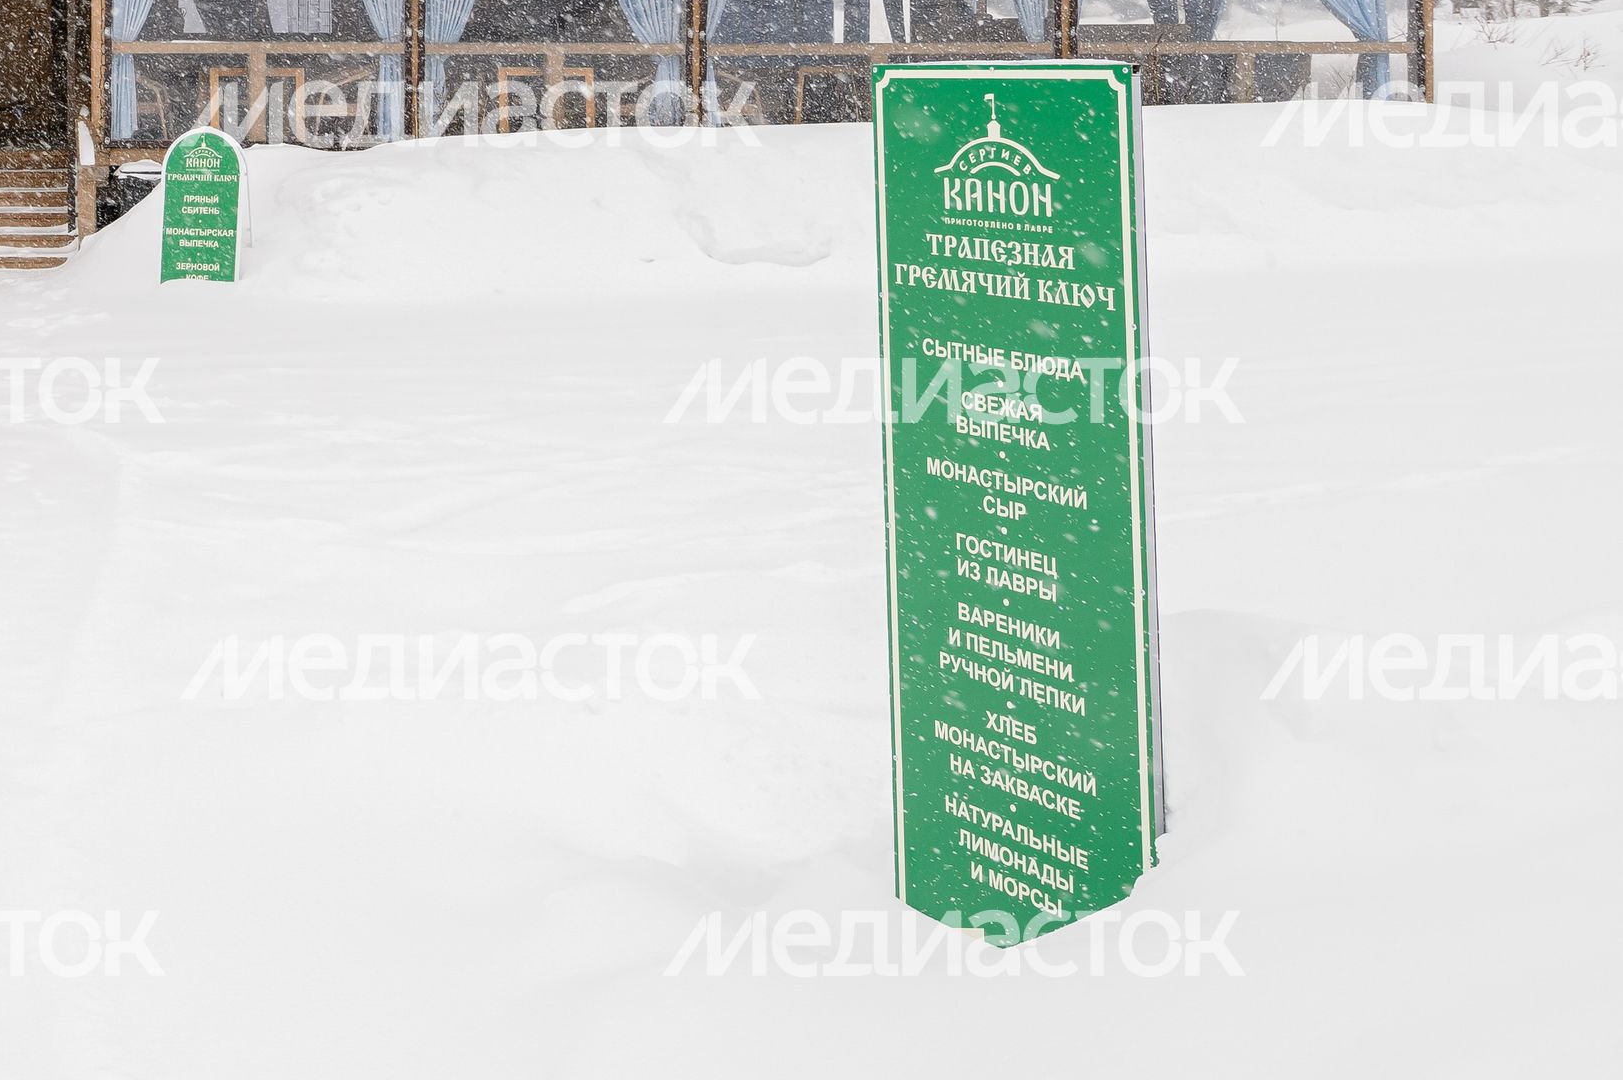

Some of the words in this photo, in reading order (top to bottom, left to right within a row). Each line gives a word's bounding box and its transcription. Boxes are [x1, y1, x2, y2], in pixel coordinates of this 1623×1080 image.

[186, 158, 220, 168] КАНОН
[959, 146, 1033, 175] СЕРГИЕВ
[181, 206, 220, 215] СБИТЕНЬ
[183, 194, 219, 204] ПРЯНЫЙ
[943, 177, 1052, 217] КАНОН
[166, 227, 234, 237] МОНАСТЫРСКАЯ
[179, 239, 219, 248] ВЫПЕЧКА
[944, 217, 1014, 230] ПРИГОТОВЛЕНО
[1016, 223, 1021, 231] В
[1024, 224, 1053, 234] ЛАВРЕ
[176, 262, 220, 272] ЗЕРНОВОЙ
[926, 233, 1075, 270] ТРАПЕЗНАЯ
[895, 263, 1031, 300] ГРЕМЯЧИЙ
[1037, 280, 1116, 311] КЛЮЧ
[922, 337, 1005, 367] СЫТНЫЕ
[1011, 350, 1085, 381] БЛЮДА
[961, 391, 1043, 422] СВЕЖАЯ
[956, 415, 1050, 451] ВЫПЕЧКА
[926, 457, 1088, 510] МОНАСТЫРСКИЙ
[982, 496, 1026, 521] СЫР
[956, 533, 1058, 579] ГОСТИНЕЦ
[956, 559, 981, 583] ИЗ
[985, 565, 1057, 602] ЛАВРЫ
[958, 602, 1060, 649] ВАРЕНИКИ
[948, 627, 961, 648] И
[966, 632, 1072, 681] ПЕЛЬМЕНИ
[939, 651, 1014, 691] РУЧНОЙ
[1019, 676, 1085, 716] ЛЕПКИ
[985, 710, 1037, 745] ХЛЕБ
[934, 720, 1097, 797] МОНАСТЫРСКИЙ
[949, 753, 975, 778] НА
[980, 764, 1081, 820] ЗАКВАСКЕ
[945, 794, 1088, 870] НАТУРАЛЬНЫЕ
[959, 830, 1073, 894] ЛИМОНАДЫ
[971, 861, 983, 882] И
[989, 869, 1063, 917] МОРСЫ
